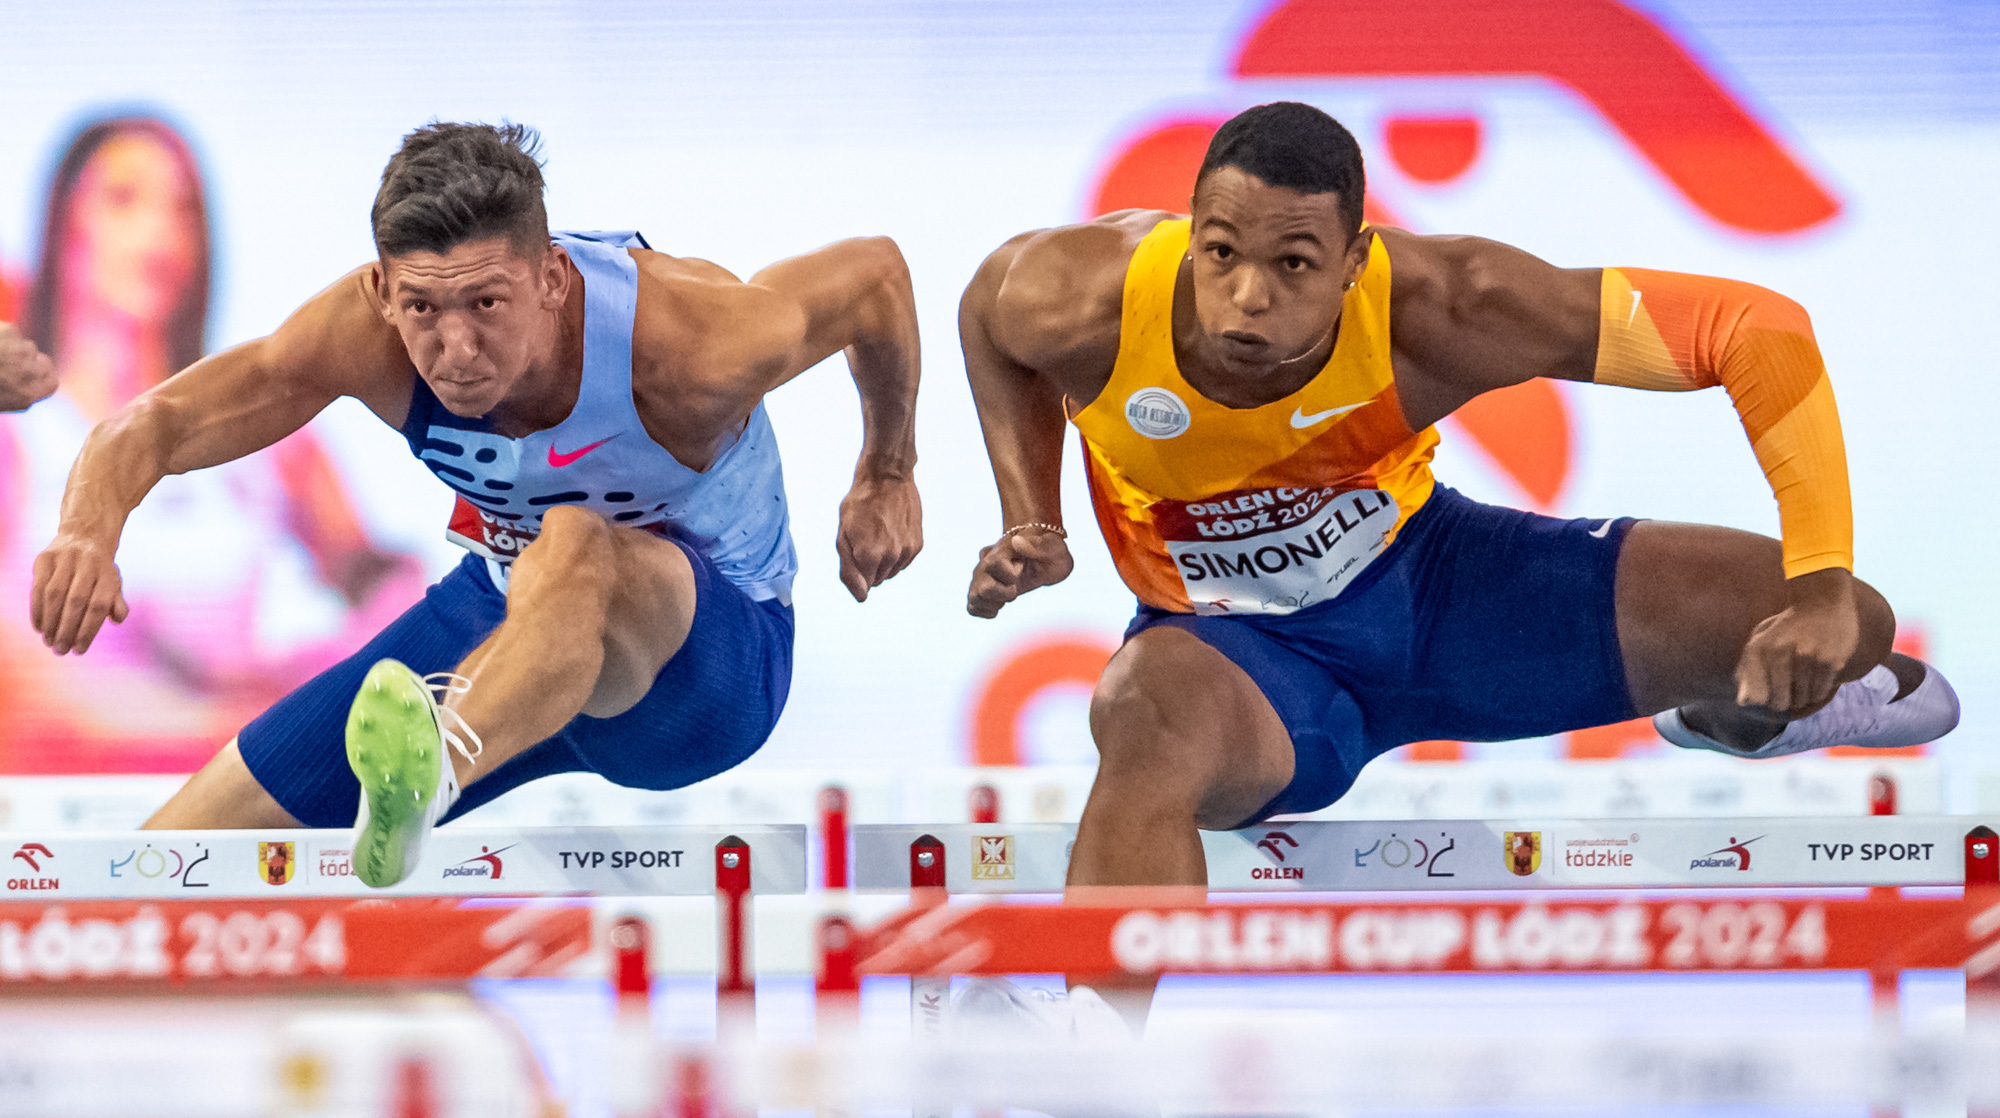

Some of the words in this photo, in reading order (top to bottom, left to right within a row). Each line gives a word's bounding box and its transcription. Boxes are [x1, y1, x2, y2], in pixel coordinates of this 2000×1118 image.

[1185, 490, 1275, 516] ORLEN
[1196, 510, 1276, 537] ŁÓDŹ
[1277, 487, 1334, 524] 2024
[482, 525, 534, 553] ŁÓD
[1178, 491, 1390, 581] SIMONELLI
[558, 851, 605, 869] TVP
[611, 850, 684, 868] SPORT
[1566, 849, 1634, 867] łódzkie
[1808, 843, 1854, 861] TVP
[1860, 843, 1934, 861] SPORT
[442, 865, 491, 879] polanik
[973, 864, 1014, 878] PZLA
[1689, 856, 1738, 870] polanik
[1251, 867, 1304, 879] ORLEN
[7, 878, 60, 890] ORLEN
[179, 911, 348, 975] 2024
[1658, 902, 1828, 966] 2024
